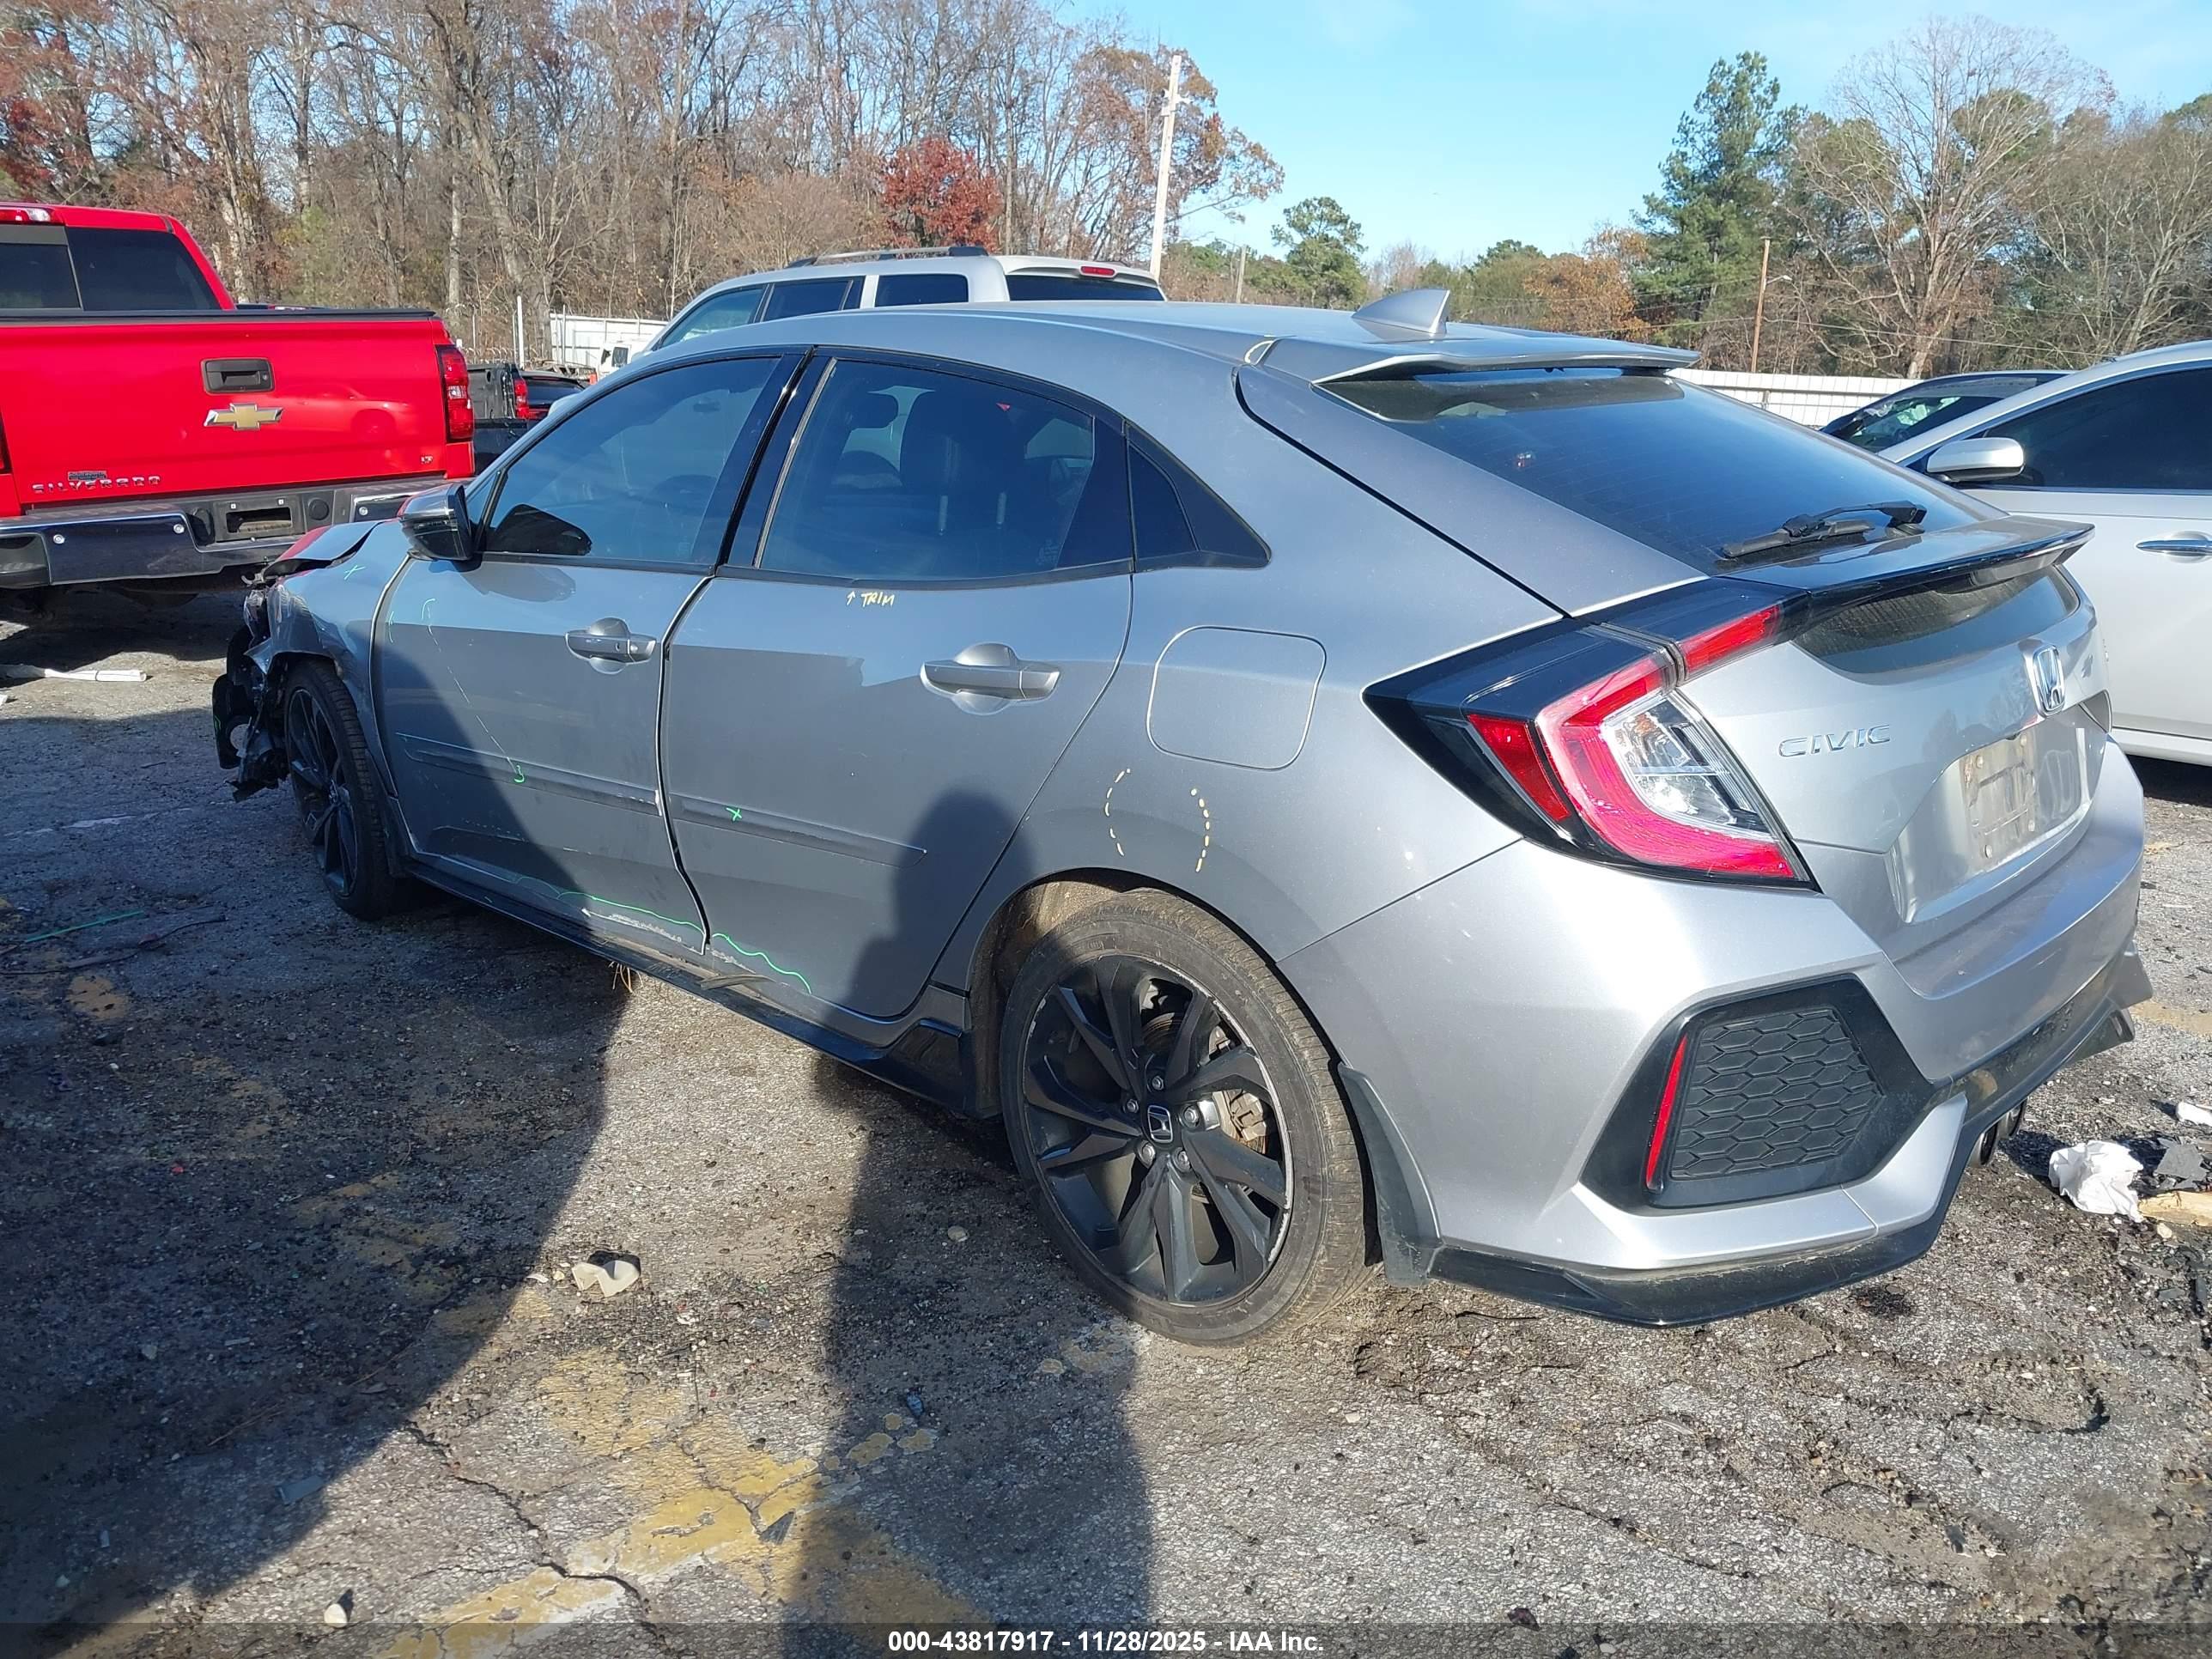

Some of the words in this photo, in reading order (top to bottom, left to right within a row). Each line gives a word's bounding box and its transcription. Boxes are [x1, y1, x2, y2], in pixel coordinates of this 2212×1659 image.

[32, 475, 161, 495] SILVERADO
[860, 591, 896, 608] TRIM
[1778, 724, 1892, 757] CIVIC
